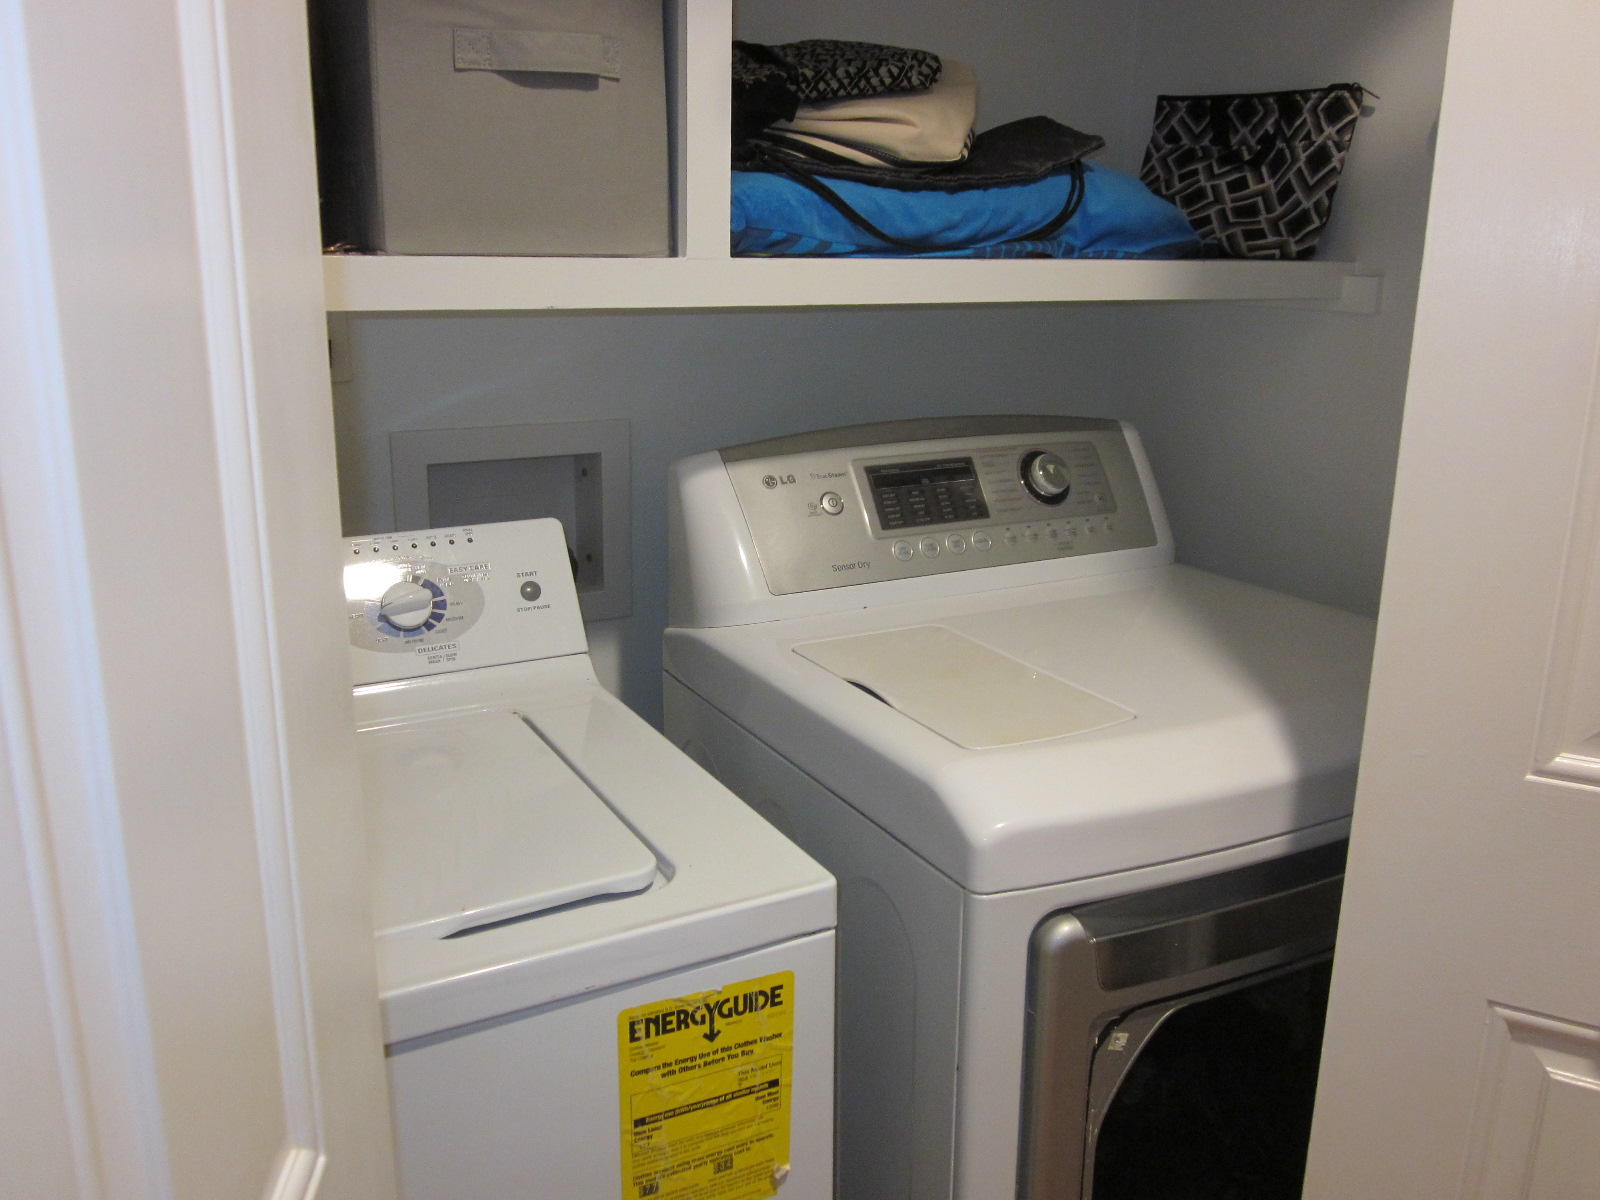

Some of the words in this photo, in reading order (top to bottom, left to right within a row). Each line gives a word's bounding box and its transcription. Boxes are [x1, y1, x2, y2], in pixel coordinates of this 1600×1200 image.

[780, 474, 796, 484] LG
[832, 562, 856, 572] Sensor
[857, 561, 871, 569] Dry
[417, 643, 457, 654] DELICATES
[629, 984, 783, 1043] ENERGYGUIDE
[660, 1070, 676, 1079] with
[703, 1058, 726, 1068] Before
[741, 1048, 754, 1057] Buy
[662, 1060, 673, 1070] the
[674, 1054, 698, 1066] Energy
[699, 1051, 711, 1061] Use
[734, 1038, 758, 1050] Clothes
